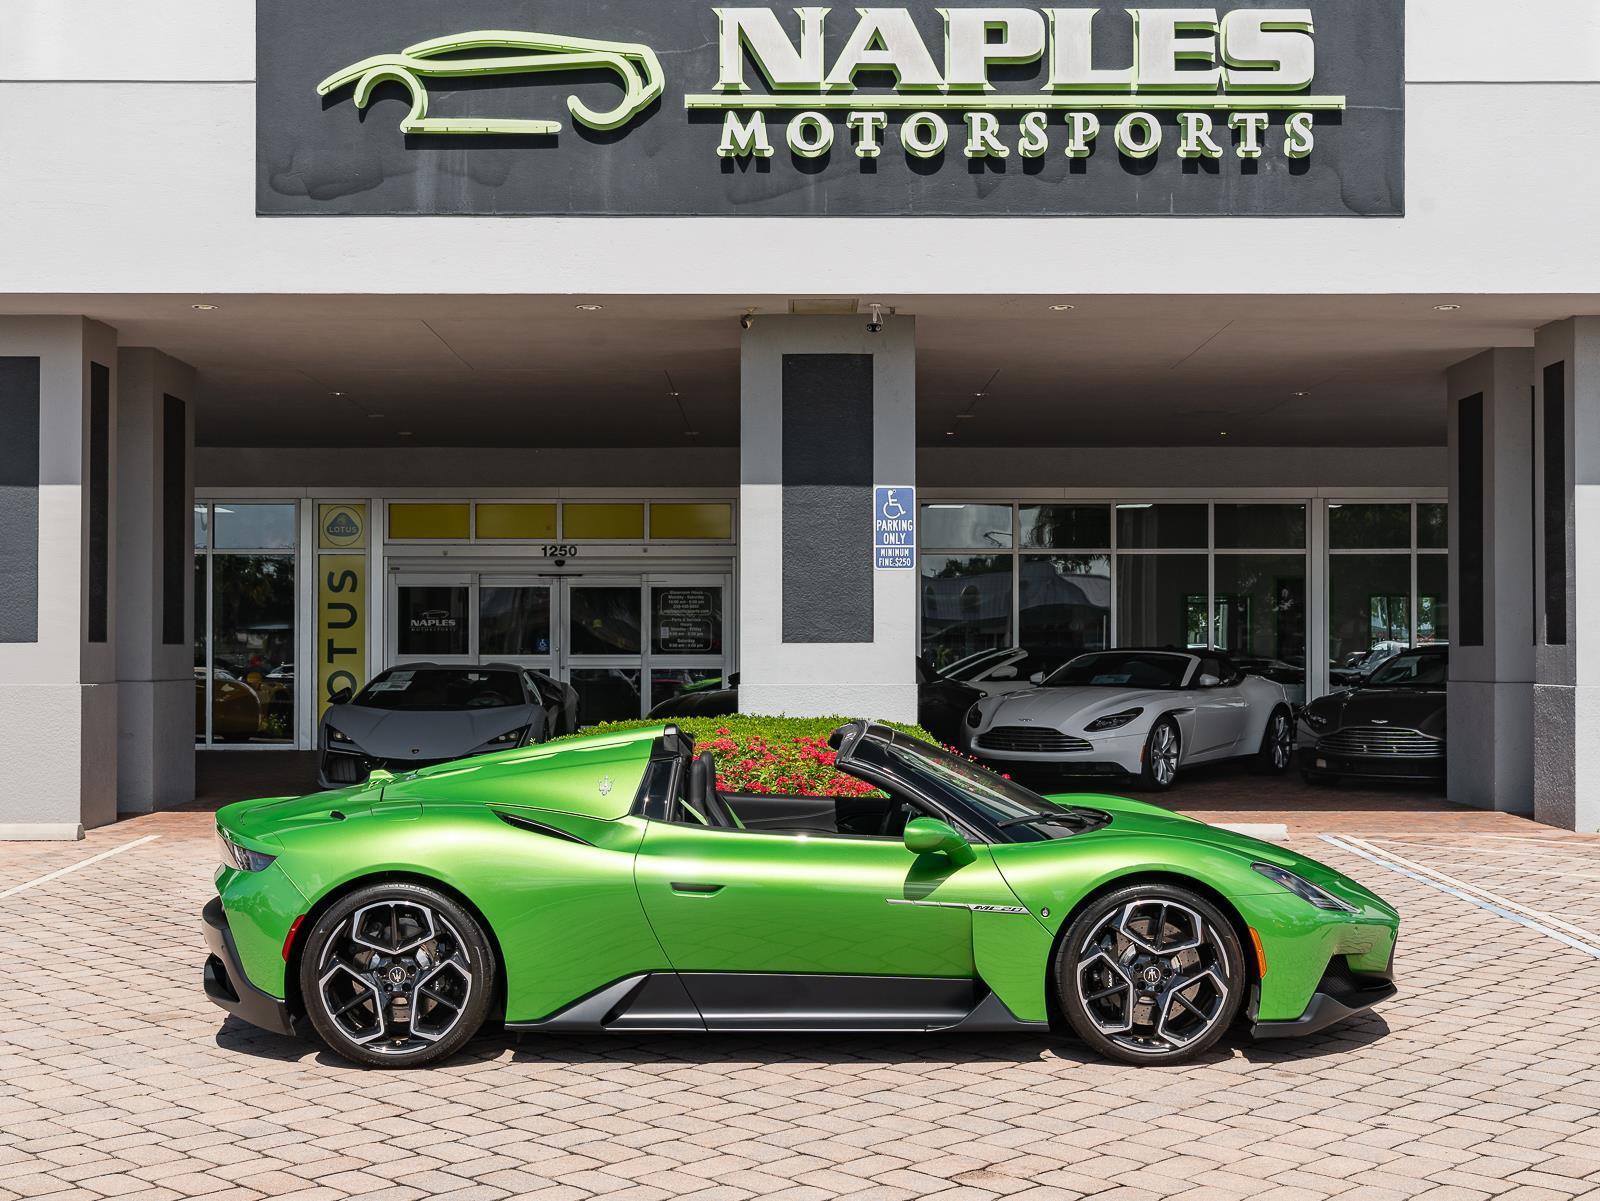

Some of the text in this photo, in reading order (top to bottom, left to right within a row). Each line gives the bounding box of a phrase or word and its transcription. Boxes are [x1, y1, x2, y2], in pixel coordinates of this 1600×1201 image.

[713, 6, 1316, 92] NAPLES
[716, 111, 1315, 159] MOTORSPORTS
[876, 520, 913, 531] PARKING
[883, 533, 906, 544] ONLY
[541, 545, 577, 557] 1250
[880, 548, 909, 557] MINIMUM
[410, 619, 456, 627] NAPLES
[327, 569, 358, 703] OTUS
